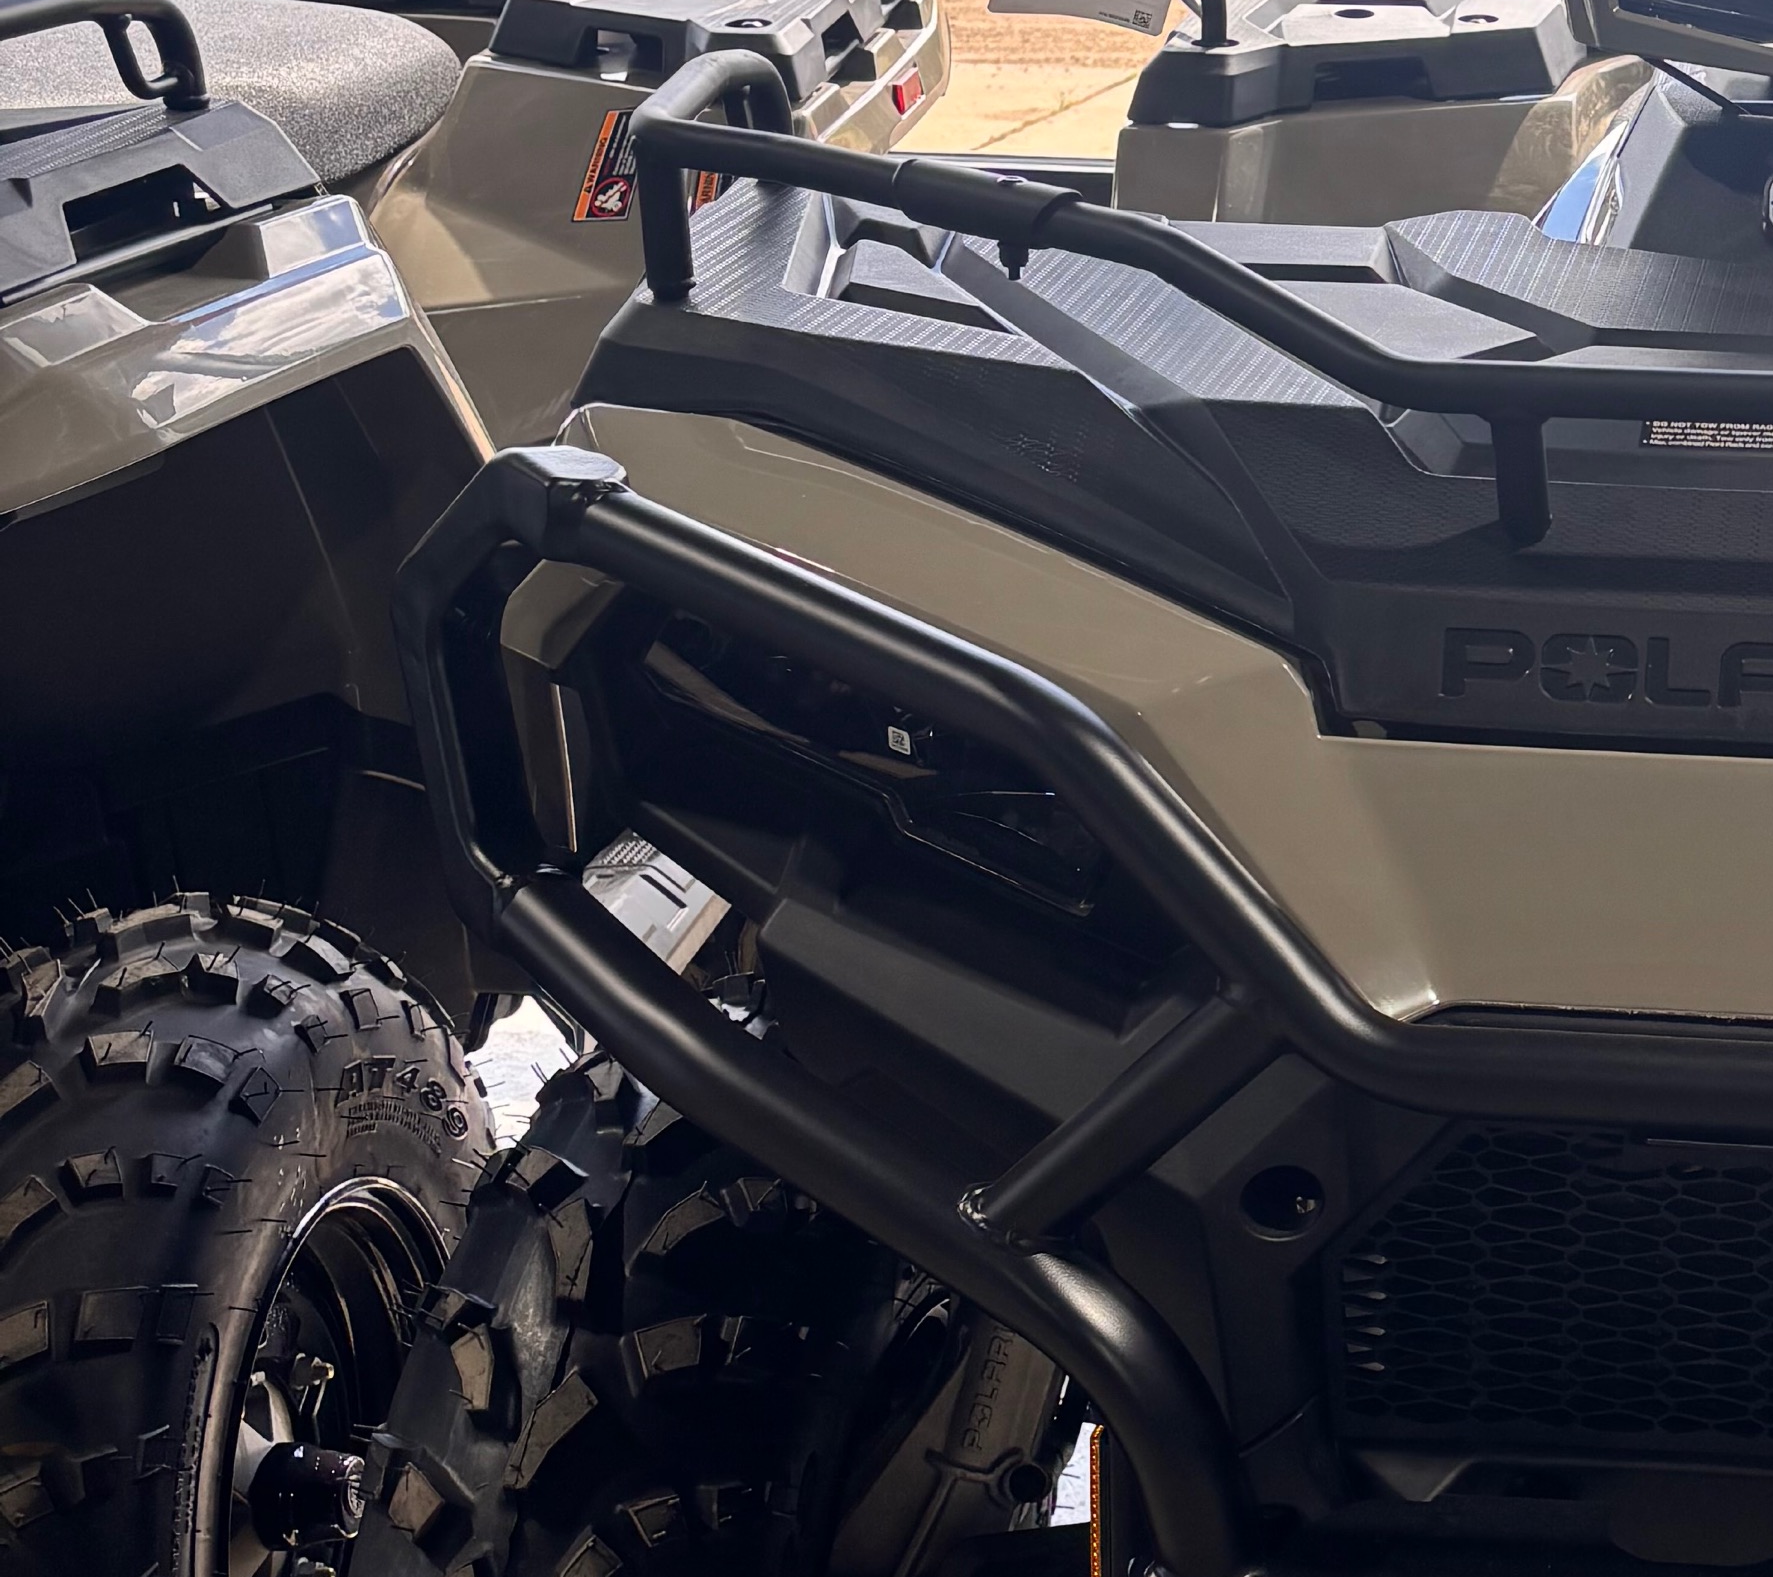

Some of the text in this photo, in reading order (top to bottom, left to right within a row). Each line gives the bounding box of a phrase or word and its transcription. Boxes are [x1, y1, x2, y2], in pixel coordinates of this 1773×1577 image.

[1652, 420, 1669, 428] DO
[1670, 421, 1693, 429] NOT
[962, 1325, 1016, 1450] POLARI
